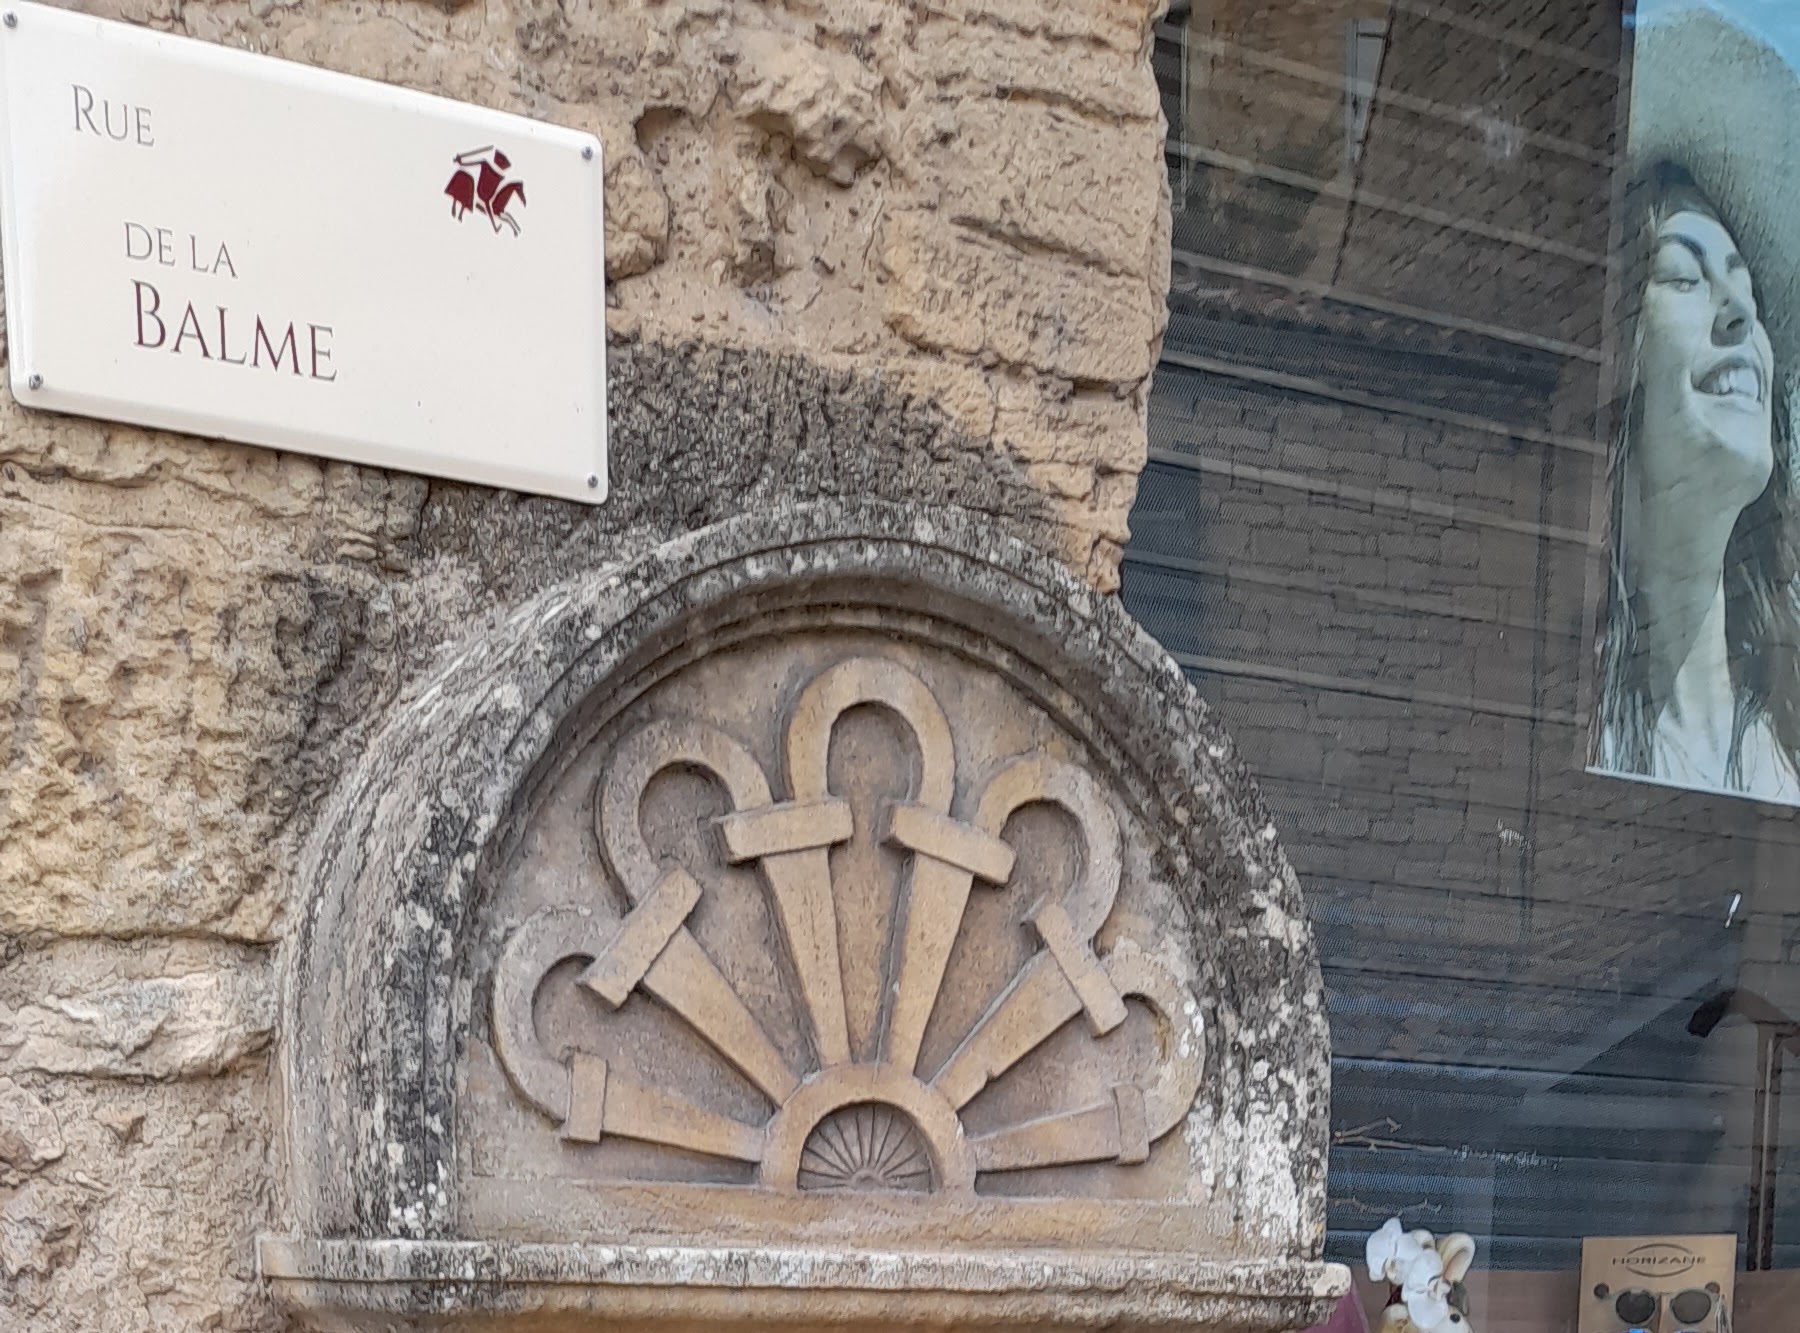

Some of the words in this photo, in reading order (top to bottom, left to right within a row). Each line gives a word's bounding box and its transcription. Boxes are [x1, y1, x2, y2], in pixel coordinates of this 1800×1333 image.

[71, 84, 155, 147] RUE
[123, 222, 176, 267] DE
[189, 234, 238, 279] LA
[130, 279, 338, 383] BALME
